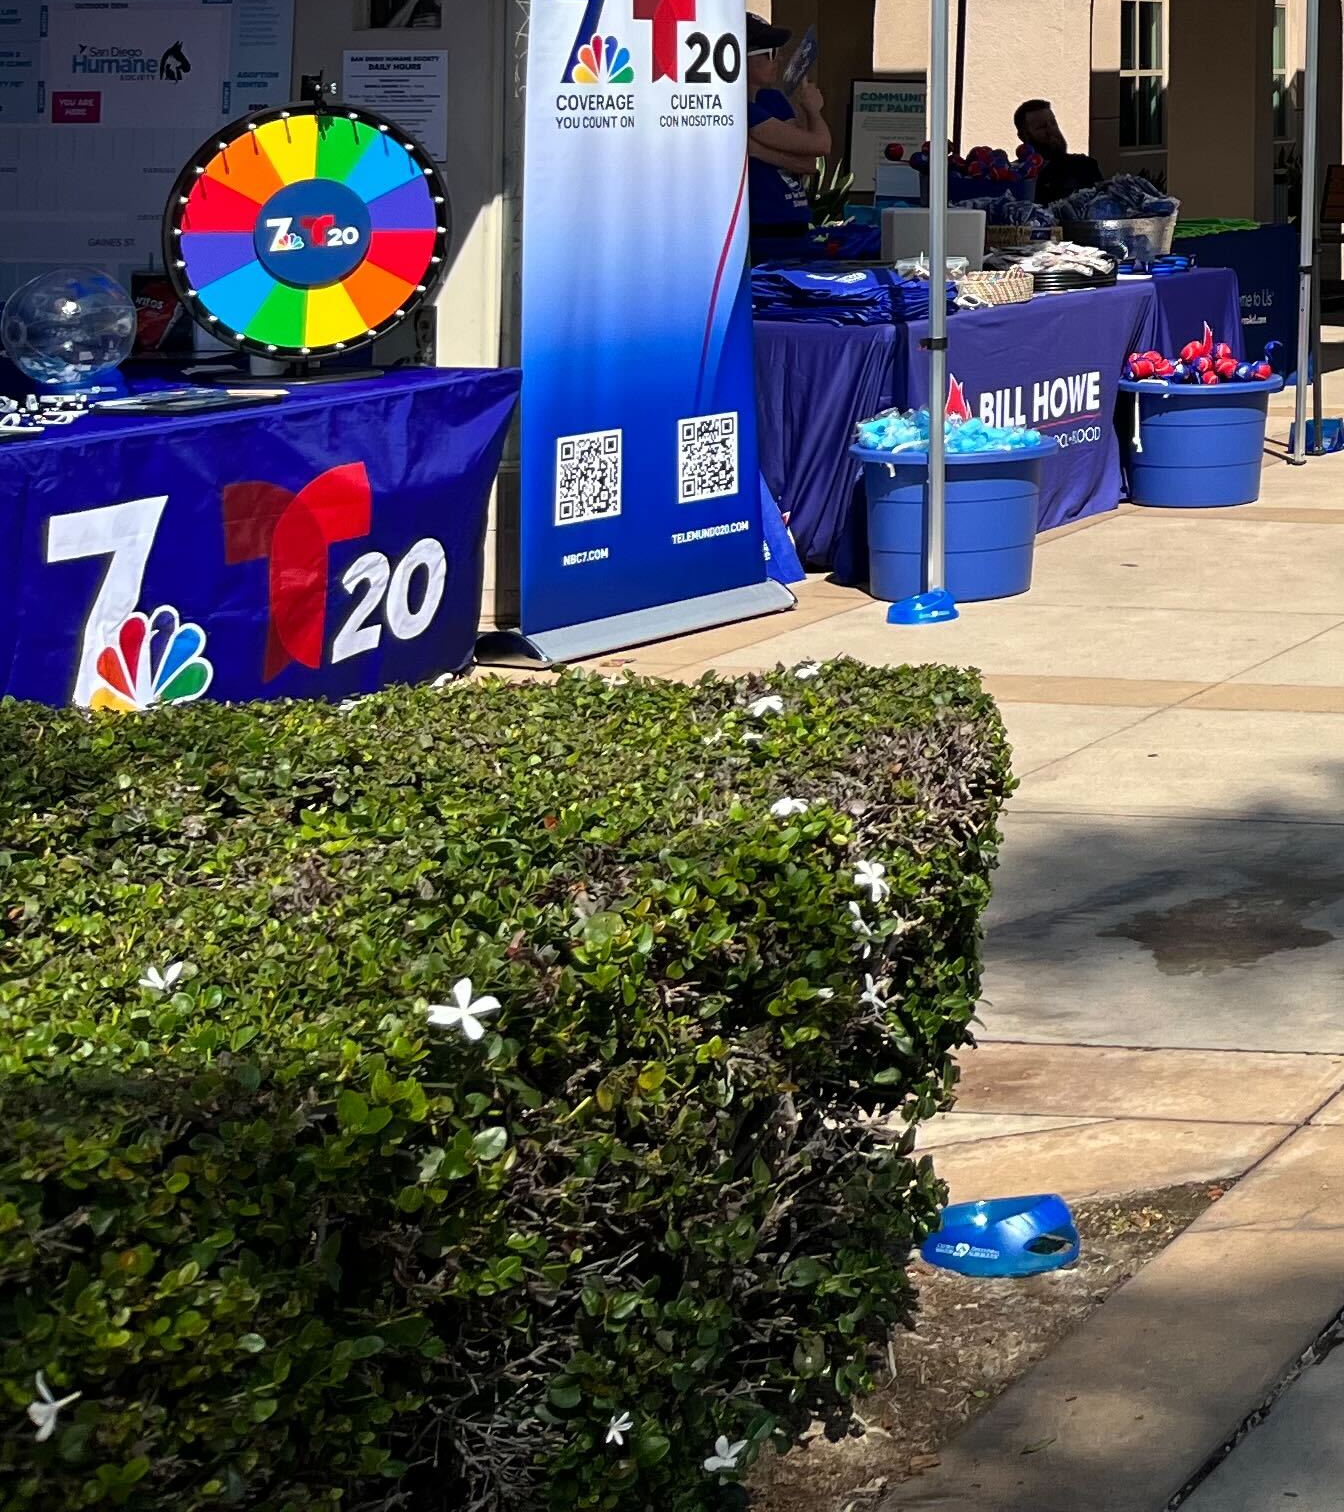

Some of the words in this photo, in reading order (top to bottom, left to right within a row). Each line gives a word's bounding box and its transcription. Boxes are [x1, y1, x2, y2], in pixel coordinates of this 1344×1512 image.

[89, 47, 108, 57] San
[110, 46, 142, 59] Diego
[685, 31, 741, 83] 20
[72, 55, 158, 74] Humane
[556, 94, 634, 111] COVERAGE
[671, 94, 722, 110] CUENTA
[860, 103, 884, 113] PET
[556, 116, 580, 129] YOU
[582, 115, 618, 129] COUNT
[620, 115, 635, 129] ON
[660, 115, 679, 127] CON
[681, 114, 734, 127] NOSOTROS
[266, 217, 292, 252] 7
[327, 226, 359, 247] 20
[980, 385, 1026, 427] BILL
[1033, 371, 1100, 423] HOWE
[671, 521, 749, 544] TELEMUNDO20.COM
[563, 548, 609, 566] NBC7.COM
[47, 495, 168, 706] 7
[332, 538, 446, 663] 20
